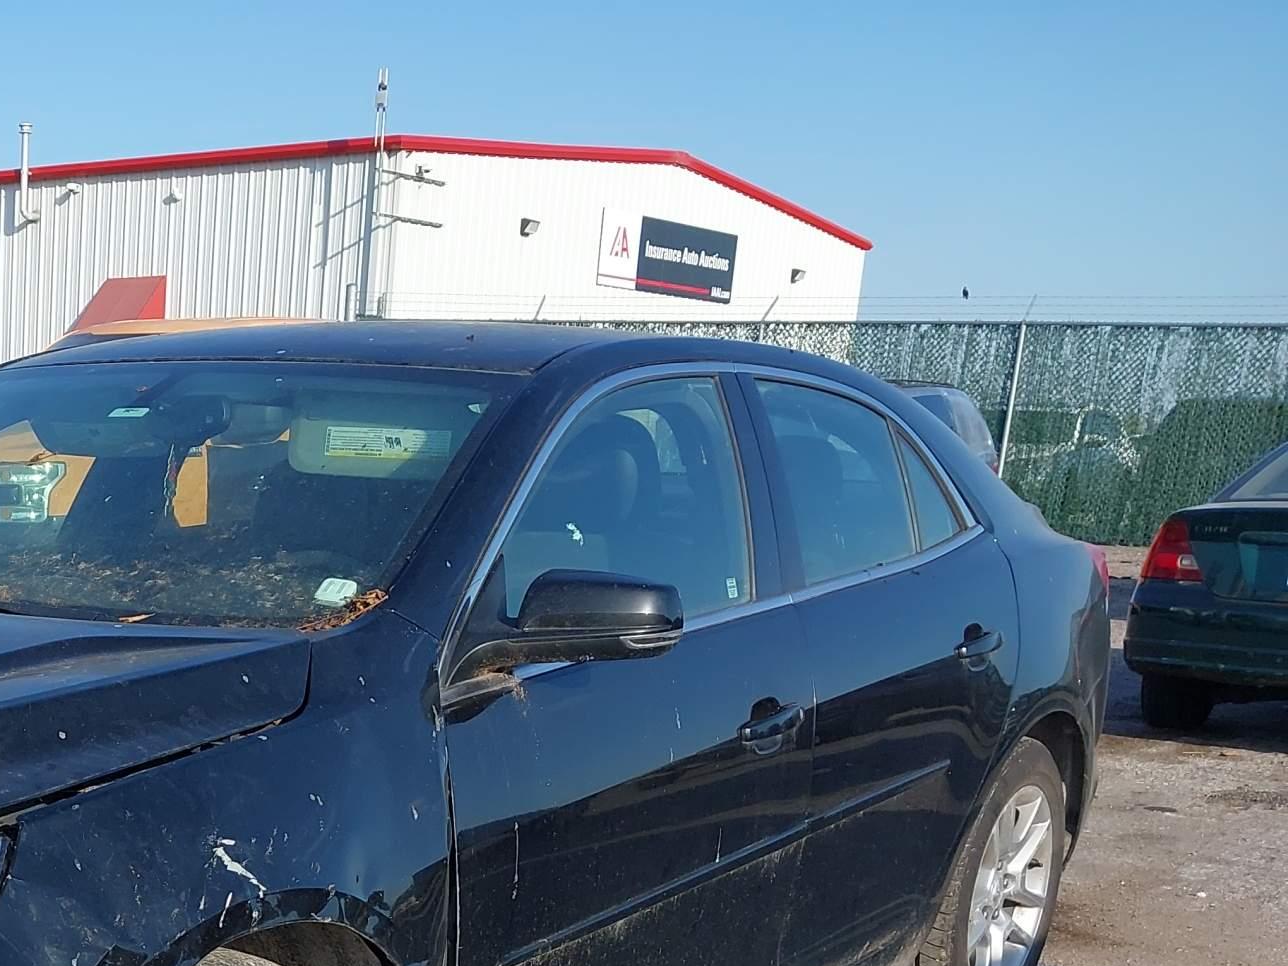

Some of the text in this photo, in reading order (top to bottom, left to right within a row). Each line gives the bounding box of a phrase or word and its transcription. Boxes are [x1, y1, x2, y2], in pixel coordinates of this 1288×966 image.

[645, 240, 730, 271] Insurance Auto Auctions
